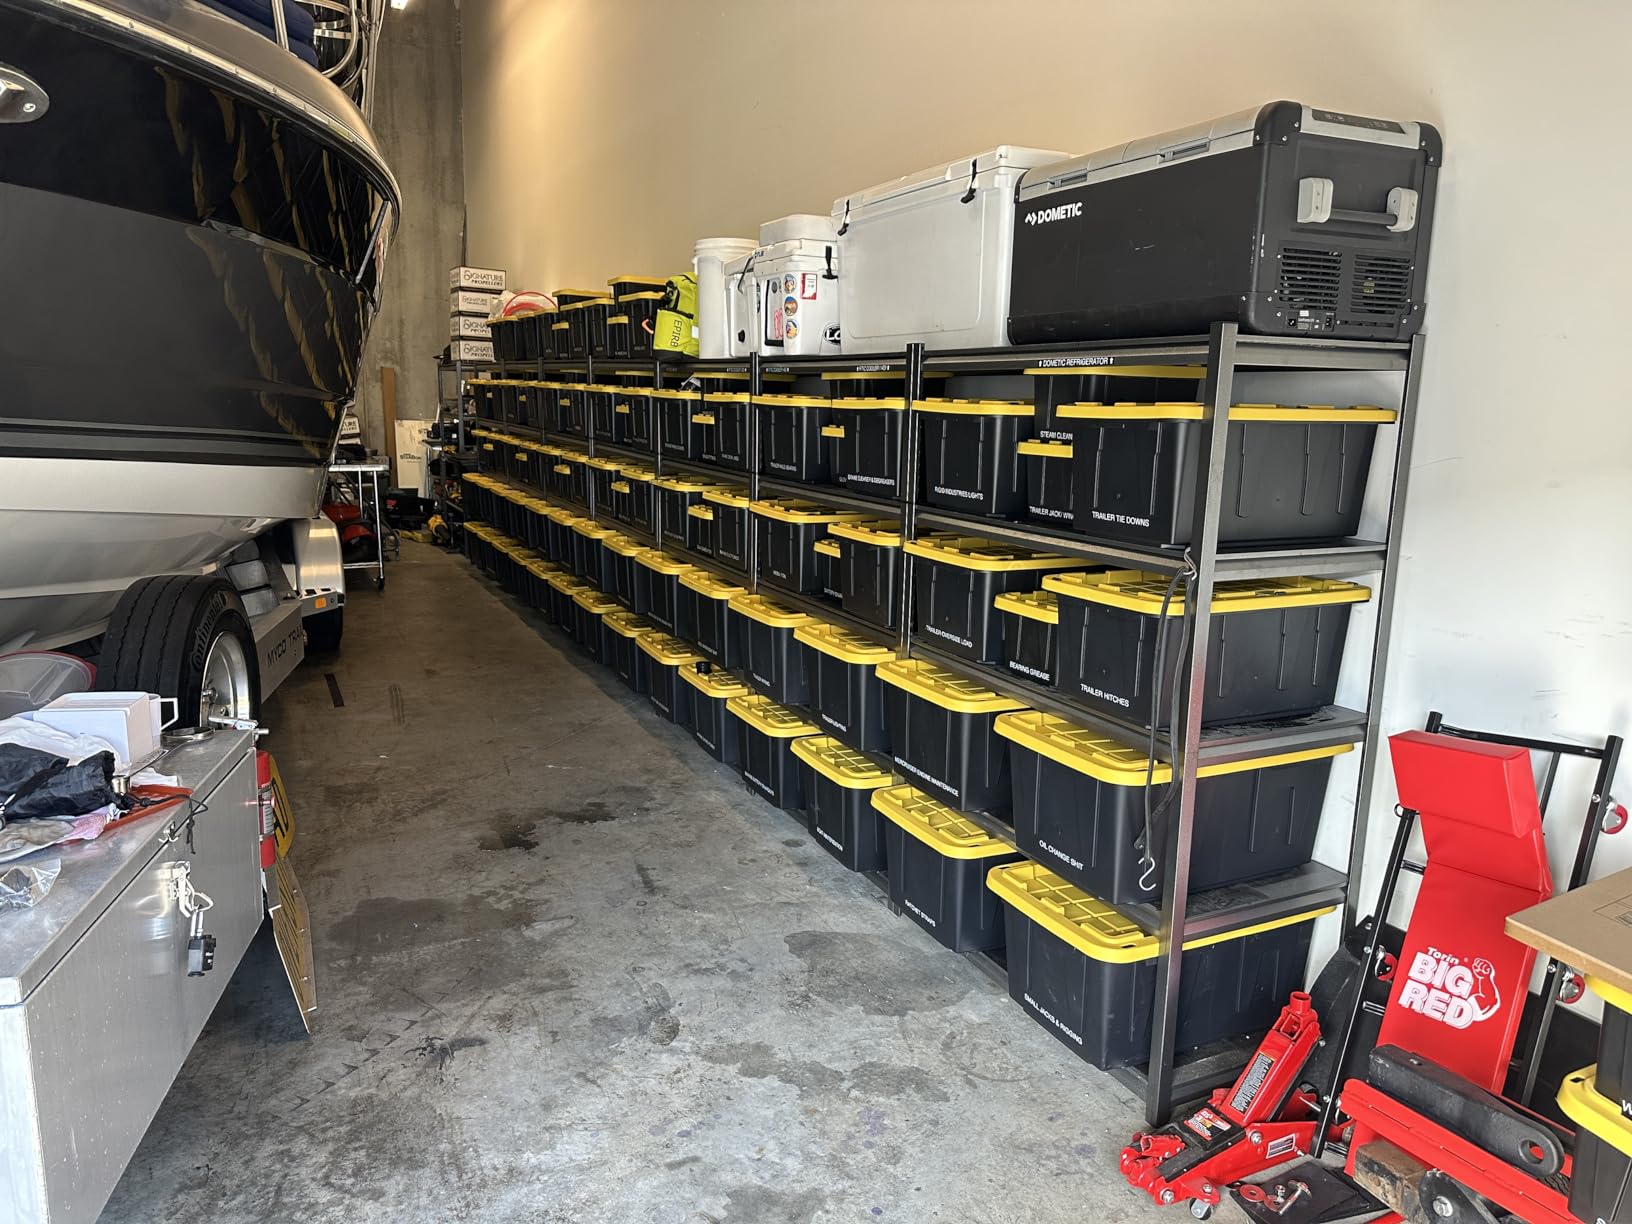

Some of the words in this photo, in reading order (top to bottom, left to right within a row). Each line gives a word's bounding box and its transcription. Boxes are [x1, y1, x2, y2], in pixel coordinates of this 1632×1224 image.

[1037, 202, 1083, 225] DOMETIC
[463, 269, 503, 282] SIGNATURE
[471, 279, 503, 287] PROPELLERS
[670, 319, 683, 348] EPIRB
[1043, 358, 1066, 368] DOMETIC
[1066, 357, 1108, 367] REFRIGERATOR
[1040, 430, 1057, 439] STEAM
[968, 491, 984, 500] LIGHTS
[1029, 505, 1049, 516] TRAILER
[1092, 511, 1116, 522] TRAILER
[1116, 514, 1126, 524] TIE
[1126, 516, 1150, 528] DOWNS
[925, 624, 942, 639] TRAILER
[941, 630, 961, 645] OVERSIZE
[961, 638, 973, 649] LOAD
[267, 639, 287, 669] MYCO
[1009, 660, 1030, 674] BEARING
[1029, 666, 1050, 682] GREASE
[1080, 683, 1104, 699] TRAILER
[1103, 690, 1130, 708] HITCHES
[916, 768, 932, 782] ENGINE
[931, 776, 959, 797] MAINTENANCE
[1039, 840, 1049, 851] OIL
[1048, 845, 1070, 863] CHANGE
[1070, 858, 1084, 871] SHIT
[1427, 946, 1459, 965] Torin
[1407, 951, 1474, 999] BIG
[1398, 978, 1474, 1029] RED
[1024, 993, 1041, 1011] SMALL
[1040, 1007, 1056, 1024] JACKS
[1060, 1022, 1083, 1046] RIGGING
